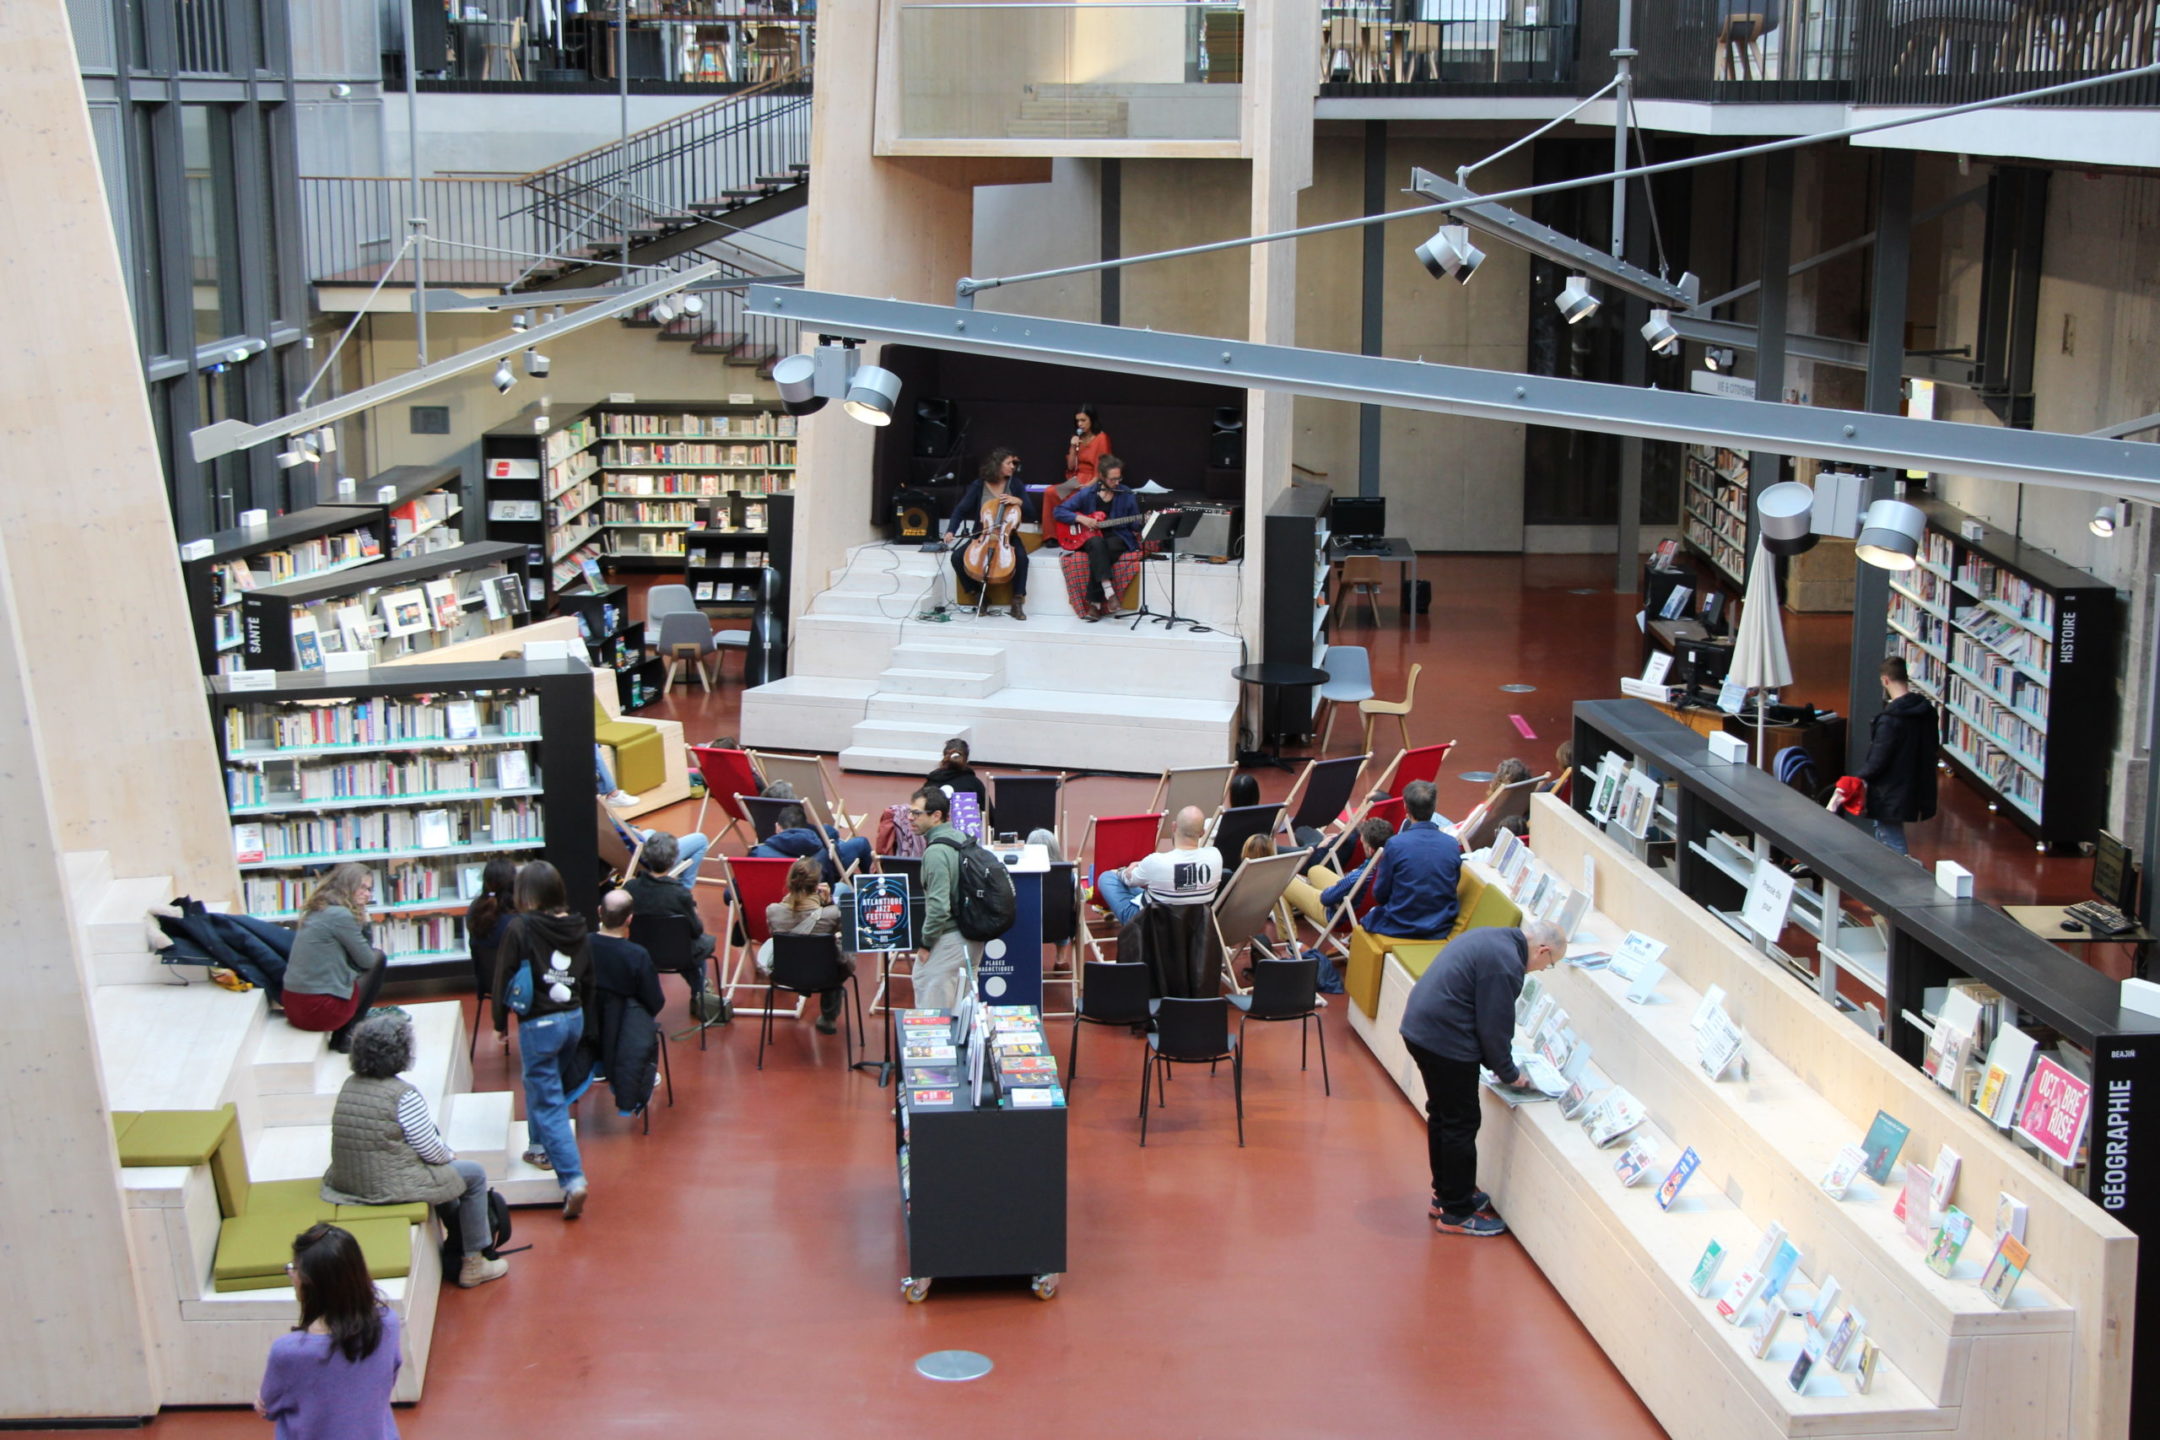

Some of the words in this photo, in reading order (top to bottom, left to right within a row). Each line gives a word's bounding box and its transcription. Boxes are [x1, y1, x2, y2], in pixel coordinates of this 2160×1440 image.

[2060, 612, 2076, 663] HISTOIRE
[1183, 862, 1211, 887] 10
[862, 897, 903, 906] ATLANTIQUE
[875, 905, 891, 913] JAZZ
[865, 912, 898, 921] FESTIVAL
[2047, 1107, 2076, 1145] ROSE
[2101, 1079, 2132, 1210] GÉOGRAPHIE
